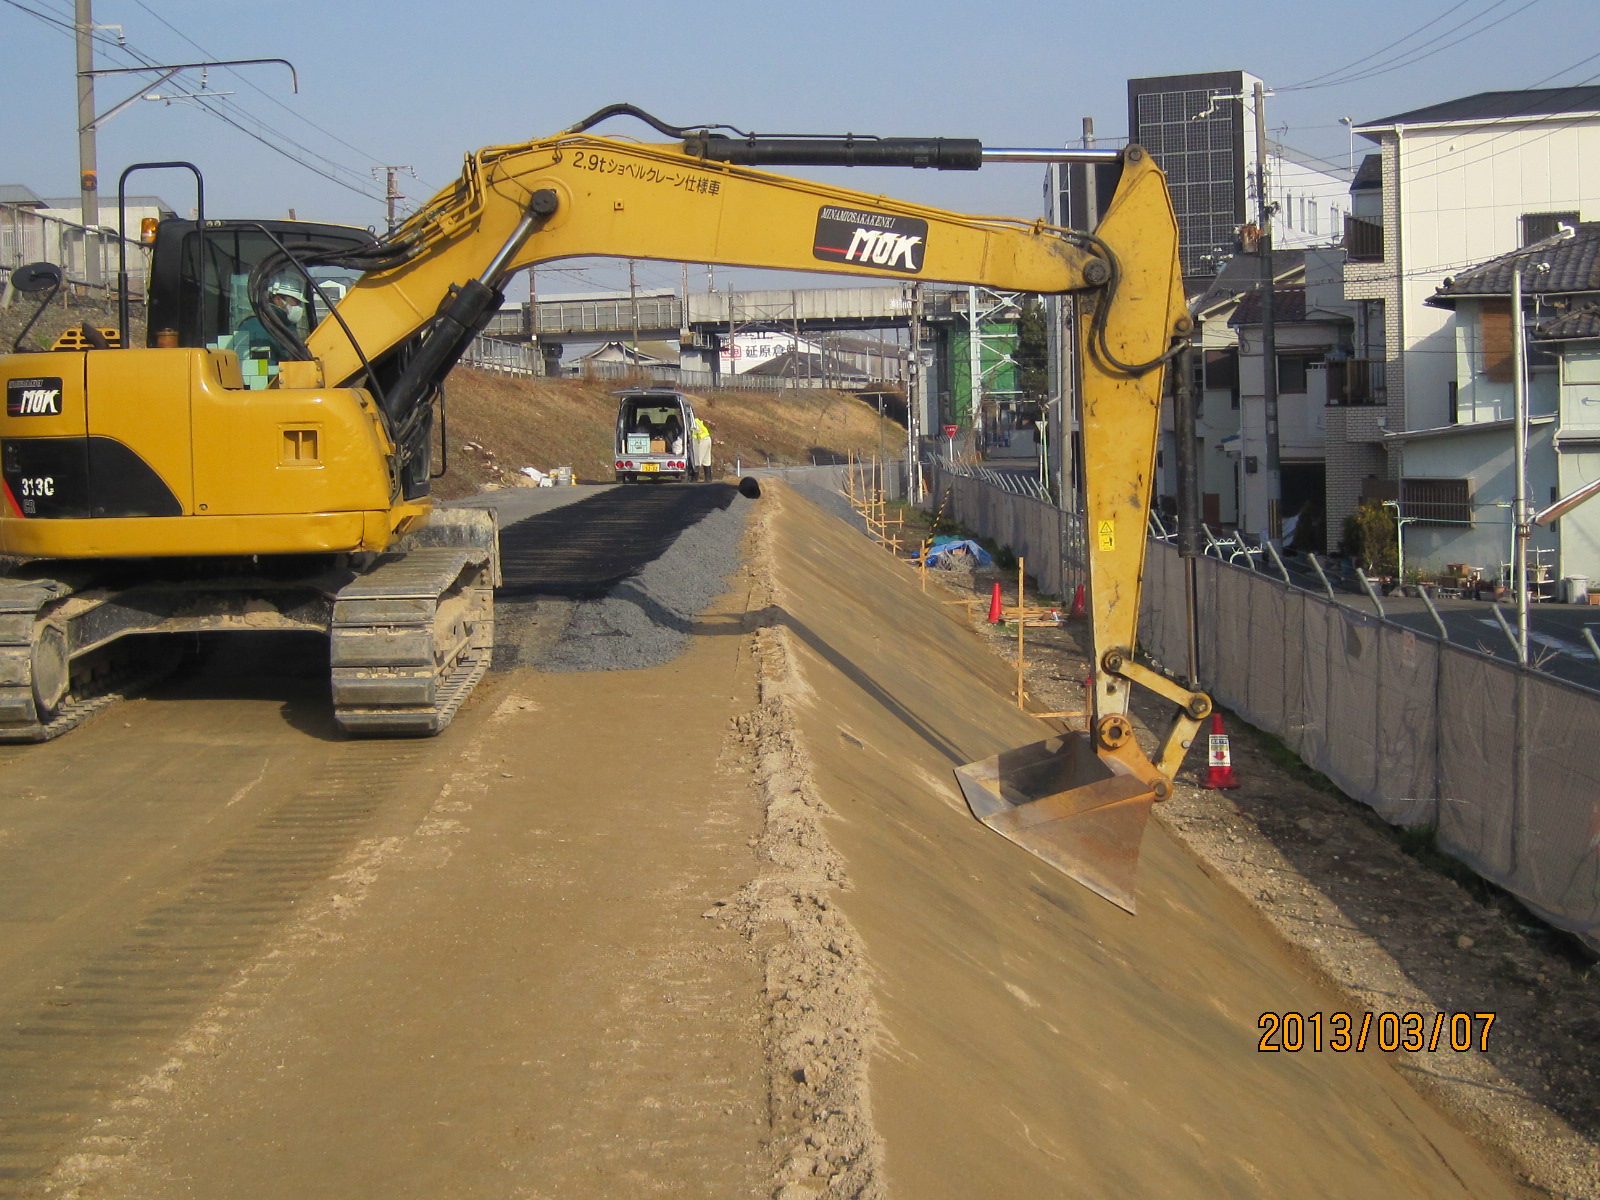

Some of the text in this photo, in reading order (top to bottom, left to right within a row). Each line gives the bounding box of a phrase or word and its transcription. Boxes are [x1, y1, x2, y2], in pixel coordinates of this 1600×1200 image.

[572, 151, 721, 196] 2.9tショベルクレーン仕様車
[820, 207, 896, 229] MINAMIOSAKAKENKI
[845, 227, 923, 270] MOK
[20, 389, 60, 414] MOK
[21, 477, 55, 496] 313C
